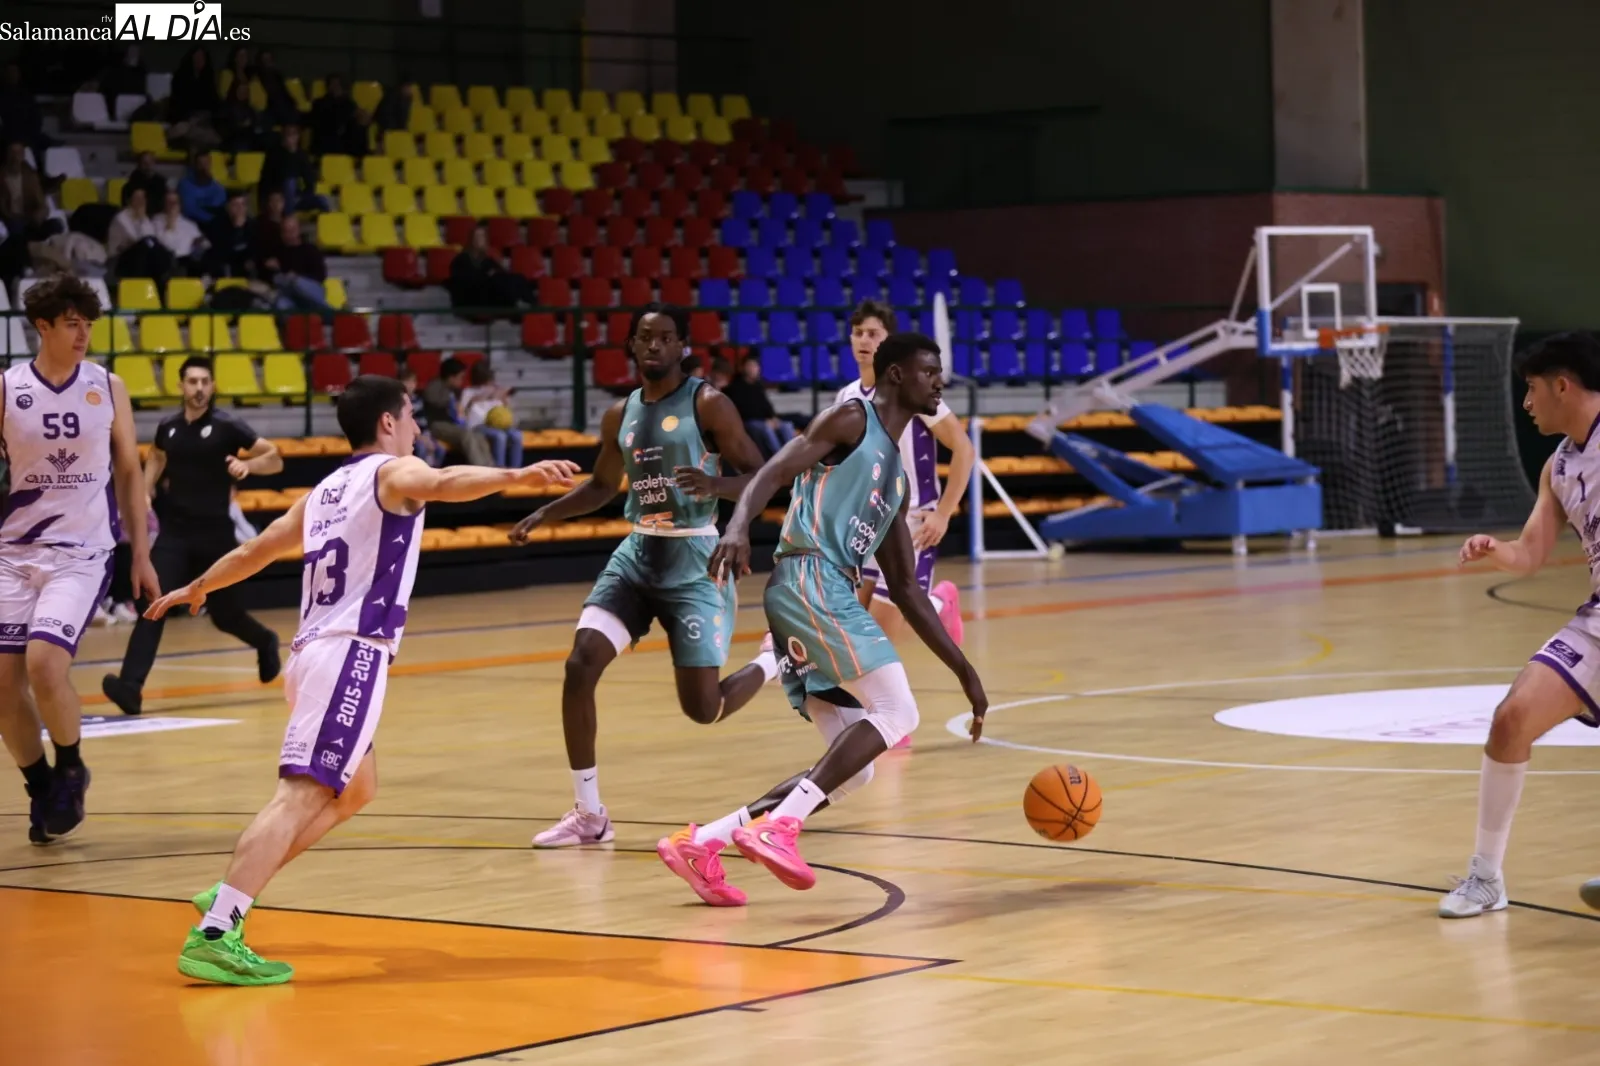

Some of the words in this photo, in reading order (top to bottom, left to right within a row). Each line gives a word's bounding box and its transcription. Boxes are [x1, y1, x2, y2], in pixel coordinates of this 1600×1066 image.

[43, 412, 81, 440] 59
[24, 474, 53, 484] CAJA
[57, 472, 97, 484] RURAL
[639, 487, 668, 506] salud
[321, 749, 343, 767] CBC
